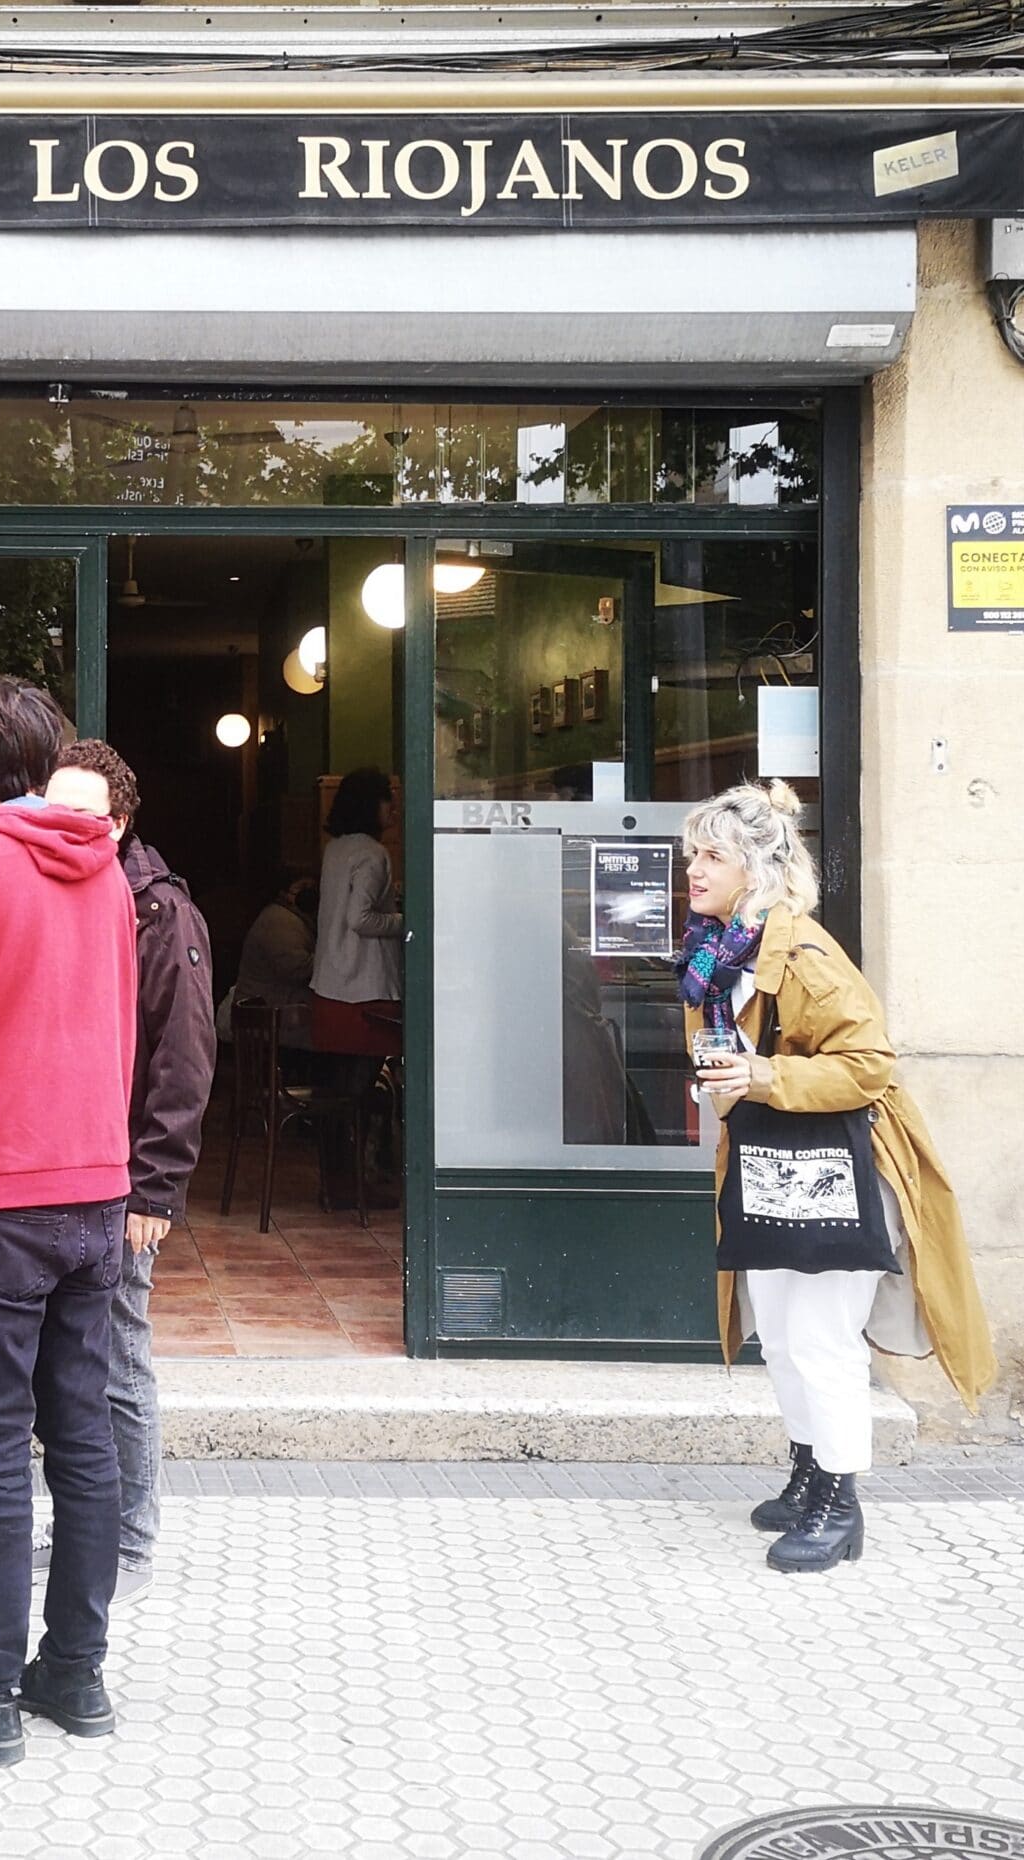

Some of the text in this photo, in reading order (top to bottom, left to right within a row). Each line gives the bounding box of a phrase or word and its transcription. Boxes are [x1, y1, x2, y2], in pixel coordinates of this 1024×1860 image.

[883, 147, 949, 176] KELER
[29, 139, 200, 203] LOS
[297, 136, 750, 217] RIOJANOS
[960, 565, 979, 573] CON
[981, 565, 1007, 573] AVISO
[462, 803, 533, 826] BAR
[598, 855, 640, 864] UNTITLED
[604, 863, 640, 872] FEST 3.0
[739, 1144, 853, 1160] RHYTHM CONTROL
